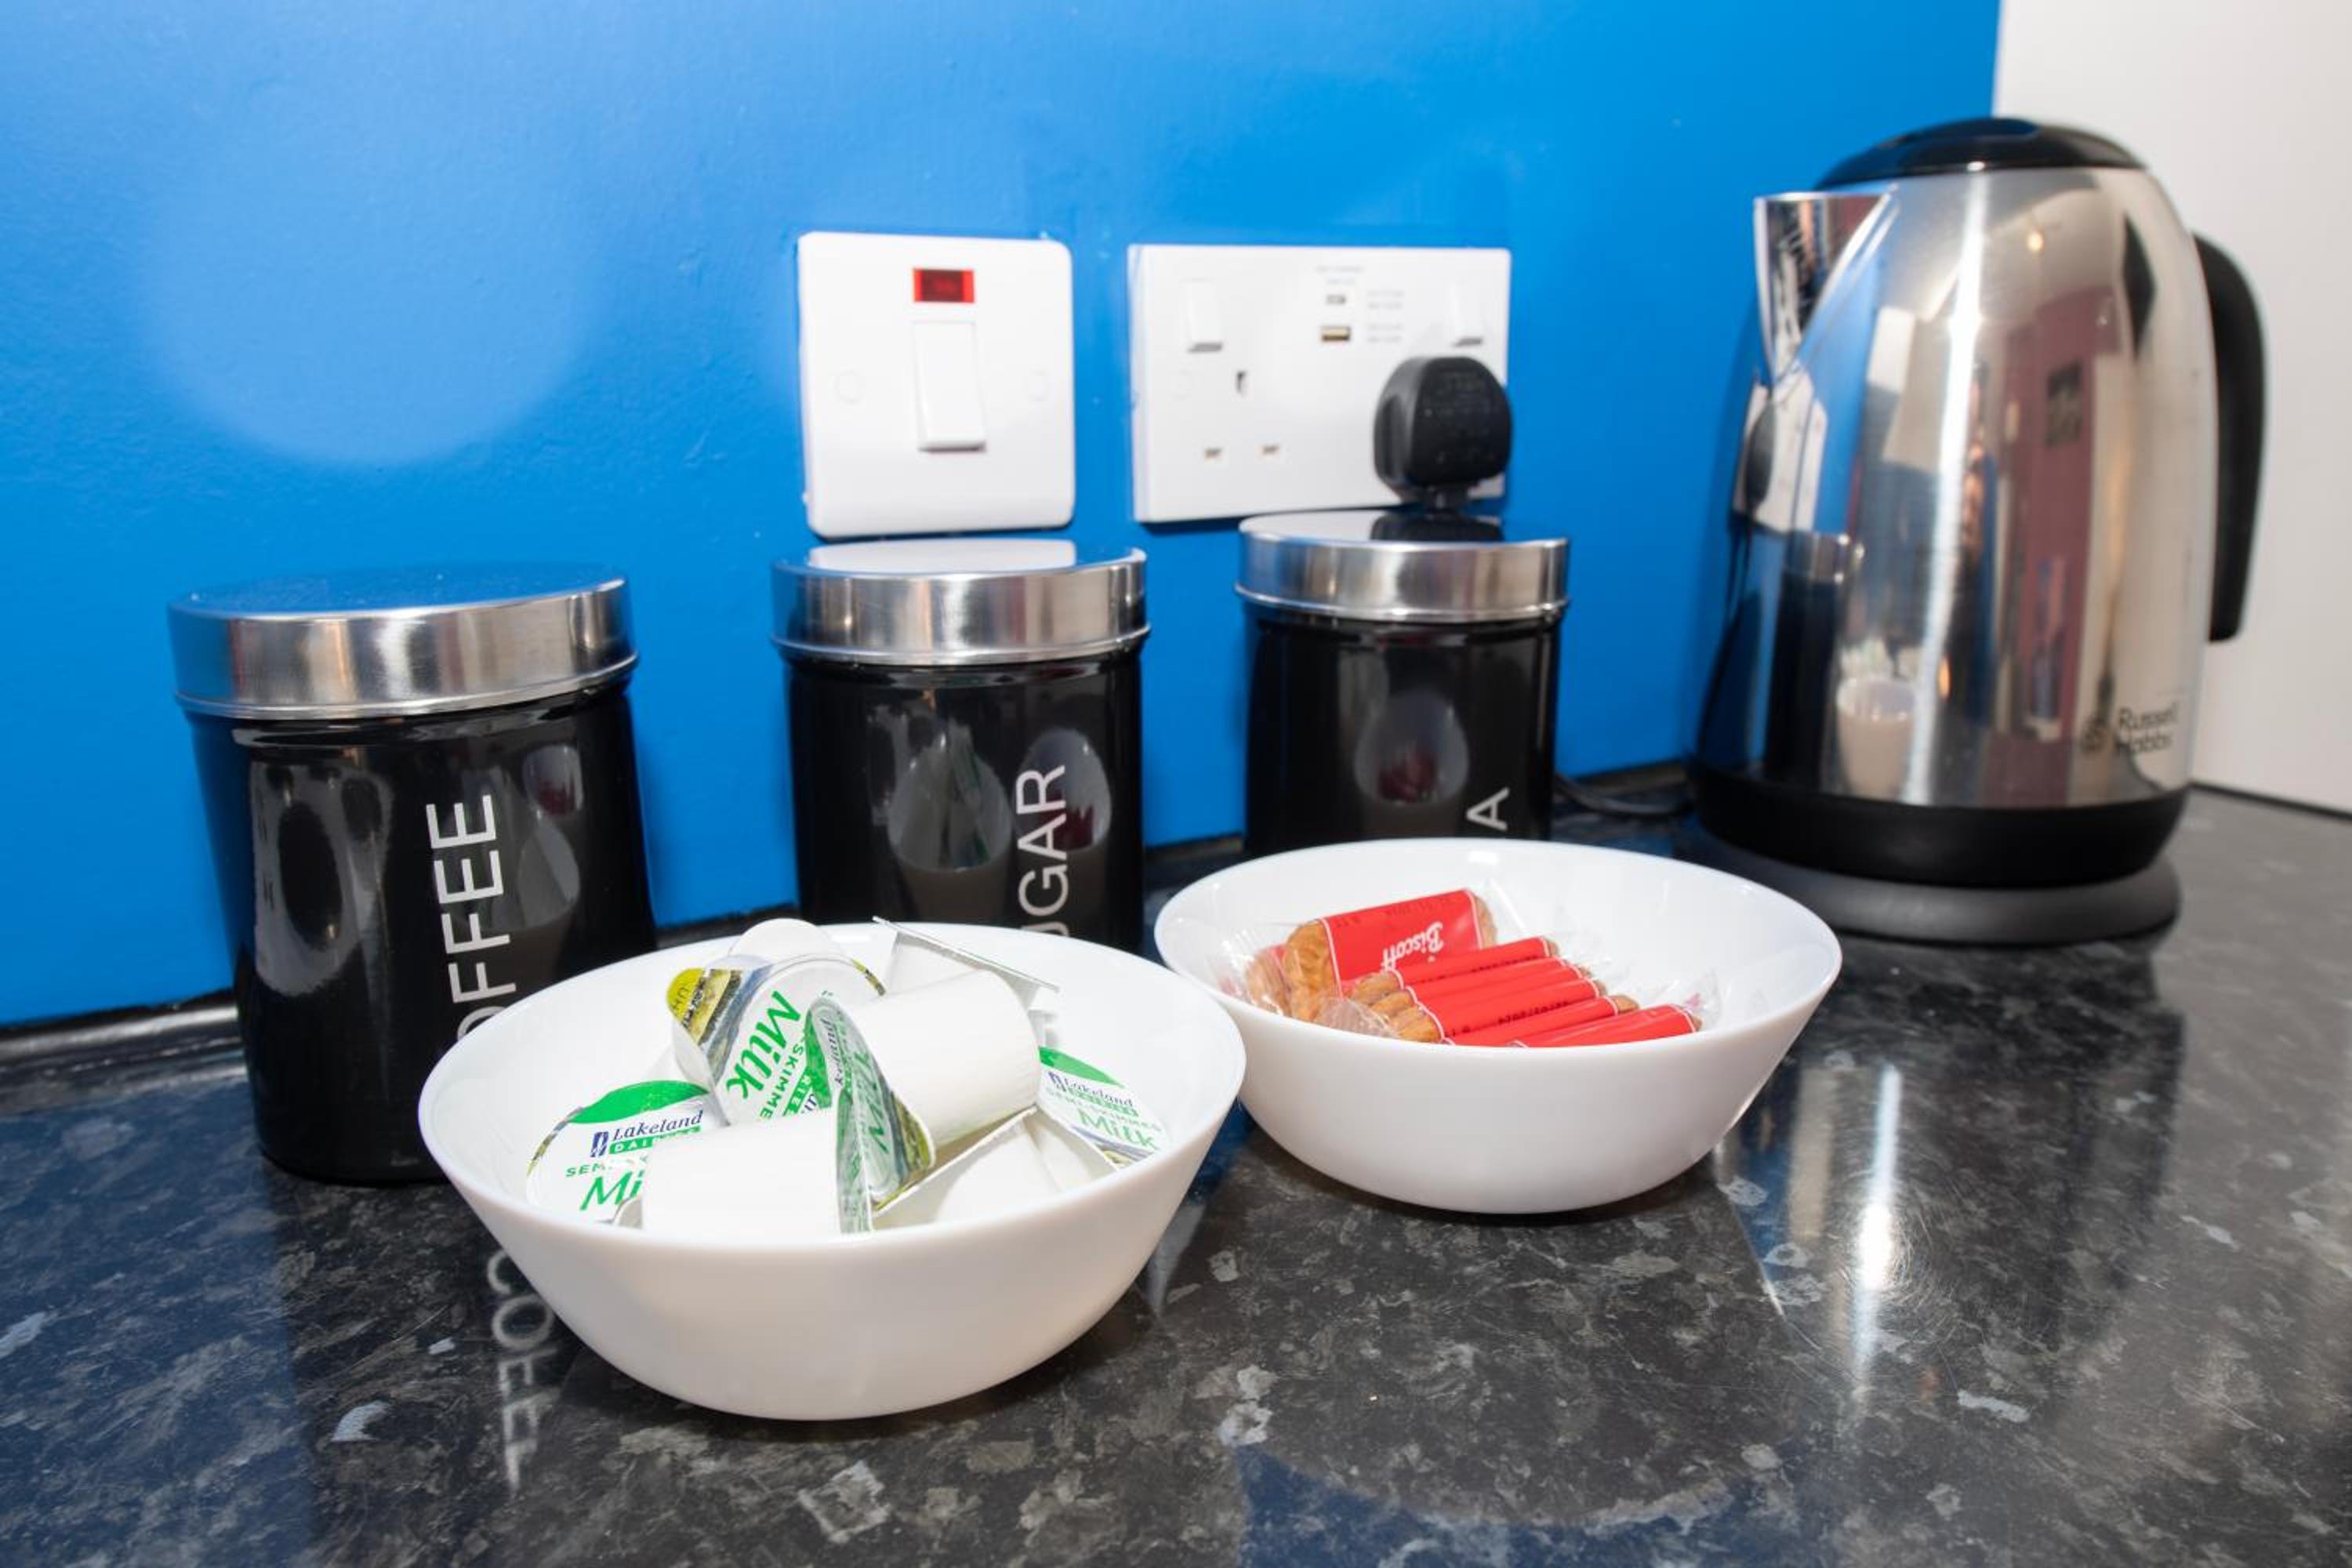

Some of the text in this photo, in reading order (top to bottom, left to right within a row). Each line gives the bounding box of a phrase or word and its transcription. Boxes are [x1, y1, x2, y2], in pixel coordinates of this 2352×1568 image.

[1381, 921, 1444, 972] Biscoff
[726, 990, 801, 1099] Milk
[612, 1109, 703, 1142] Lakeland
[1078, 1107, 1162, 1151] Milk
[579, 1170, 646, 1210] Mi
